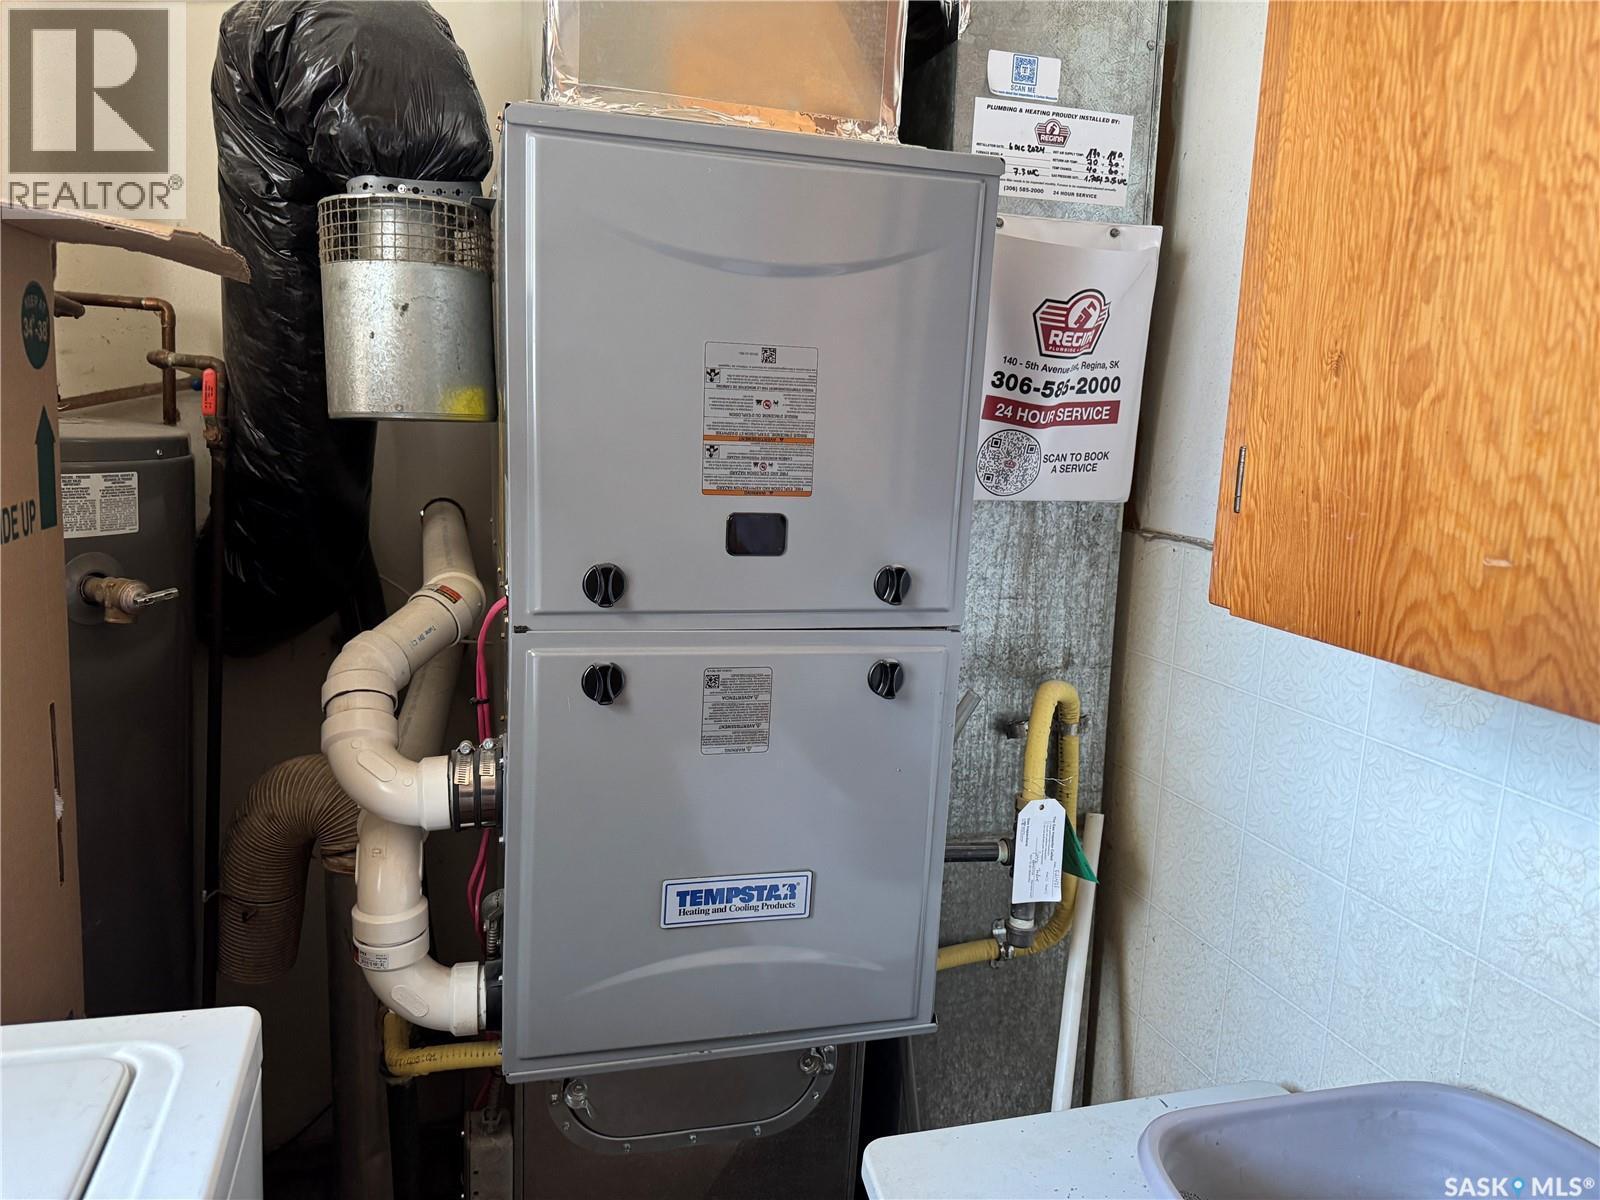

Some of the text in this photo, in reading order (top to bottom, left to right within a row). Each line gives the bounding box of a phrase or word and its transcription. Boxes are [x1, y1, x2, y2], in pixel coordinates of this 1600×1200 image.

[987, 104, 1017, 113] PLUMBING
[1025, 108, 1050, 117] HEATING
[1052, 112, 1078, 120] PROUDLY
[1079, 115, 1110, 124] INSTALLED
[1040, 135, 1064, 143] REGINA
[1028, 145, 1045, 154] 2024
[1003, 356, 1017, 366] 140
[1025, 360, 1039, 371] 5th
[1081, 361, 1107, 371] Regina,
[1109, 360, 1120, 368] SK
[991, 371, 1121, 398] 306-585-2000
[995, 403, 1111, 424] 24 HOUR SERVICE
[1042, 451, 1110, 463] SCAN TO BOOK
[1051, 463, 1098, 473] A SERVICE
[21, 498, 35, 536] UP
[676, 883, 797, 907] TEMPSTAR
[678, 902, 796, 917] Heating and Cooling Products
